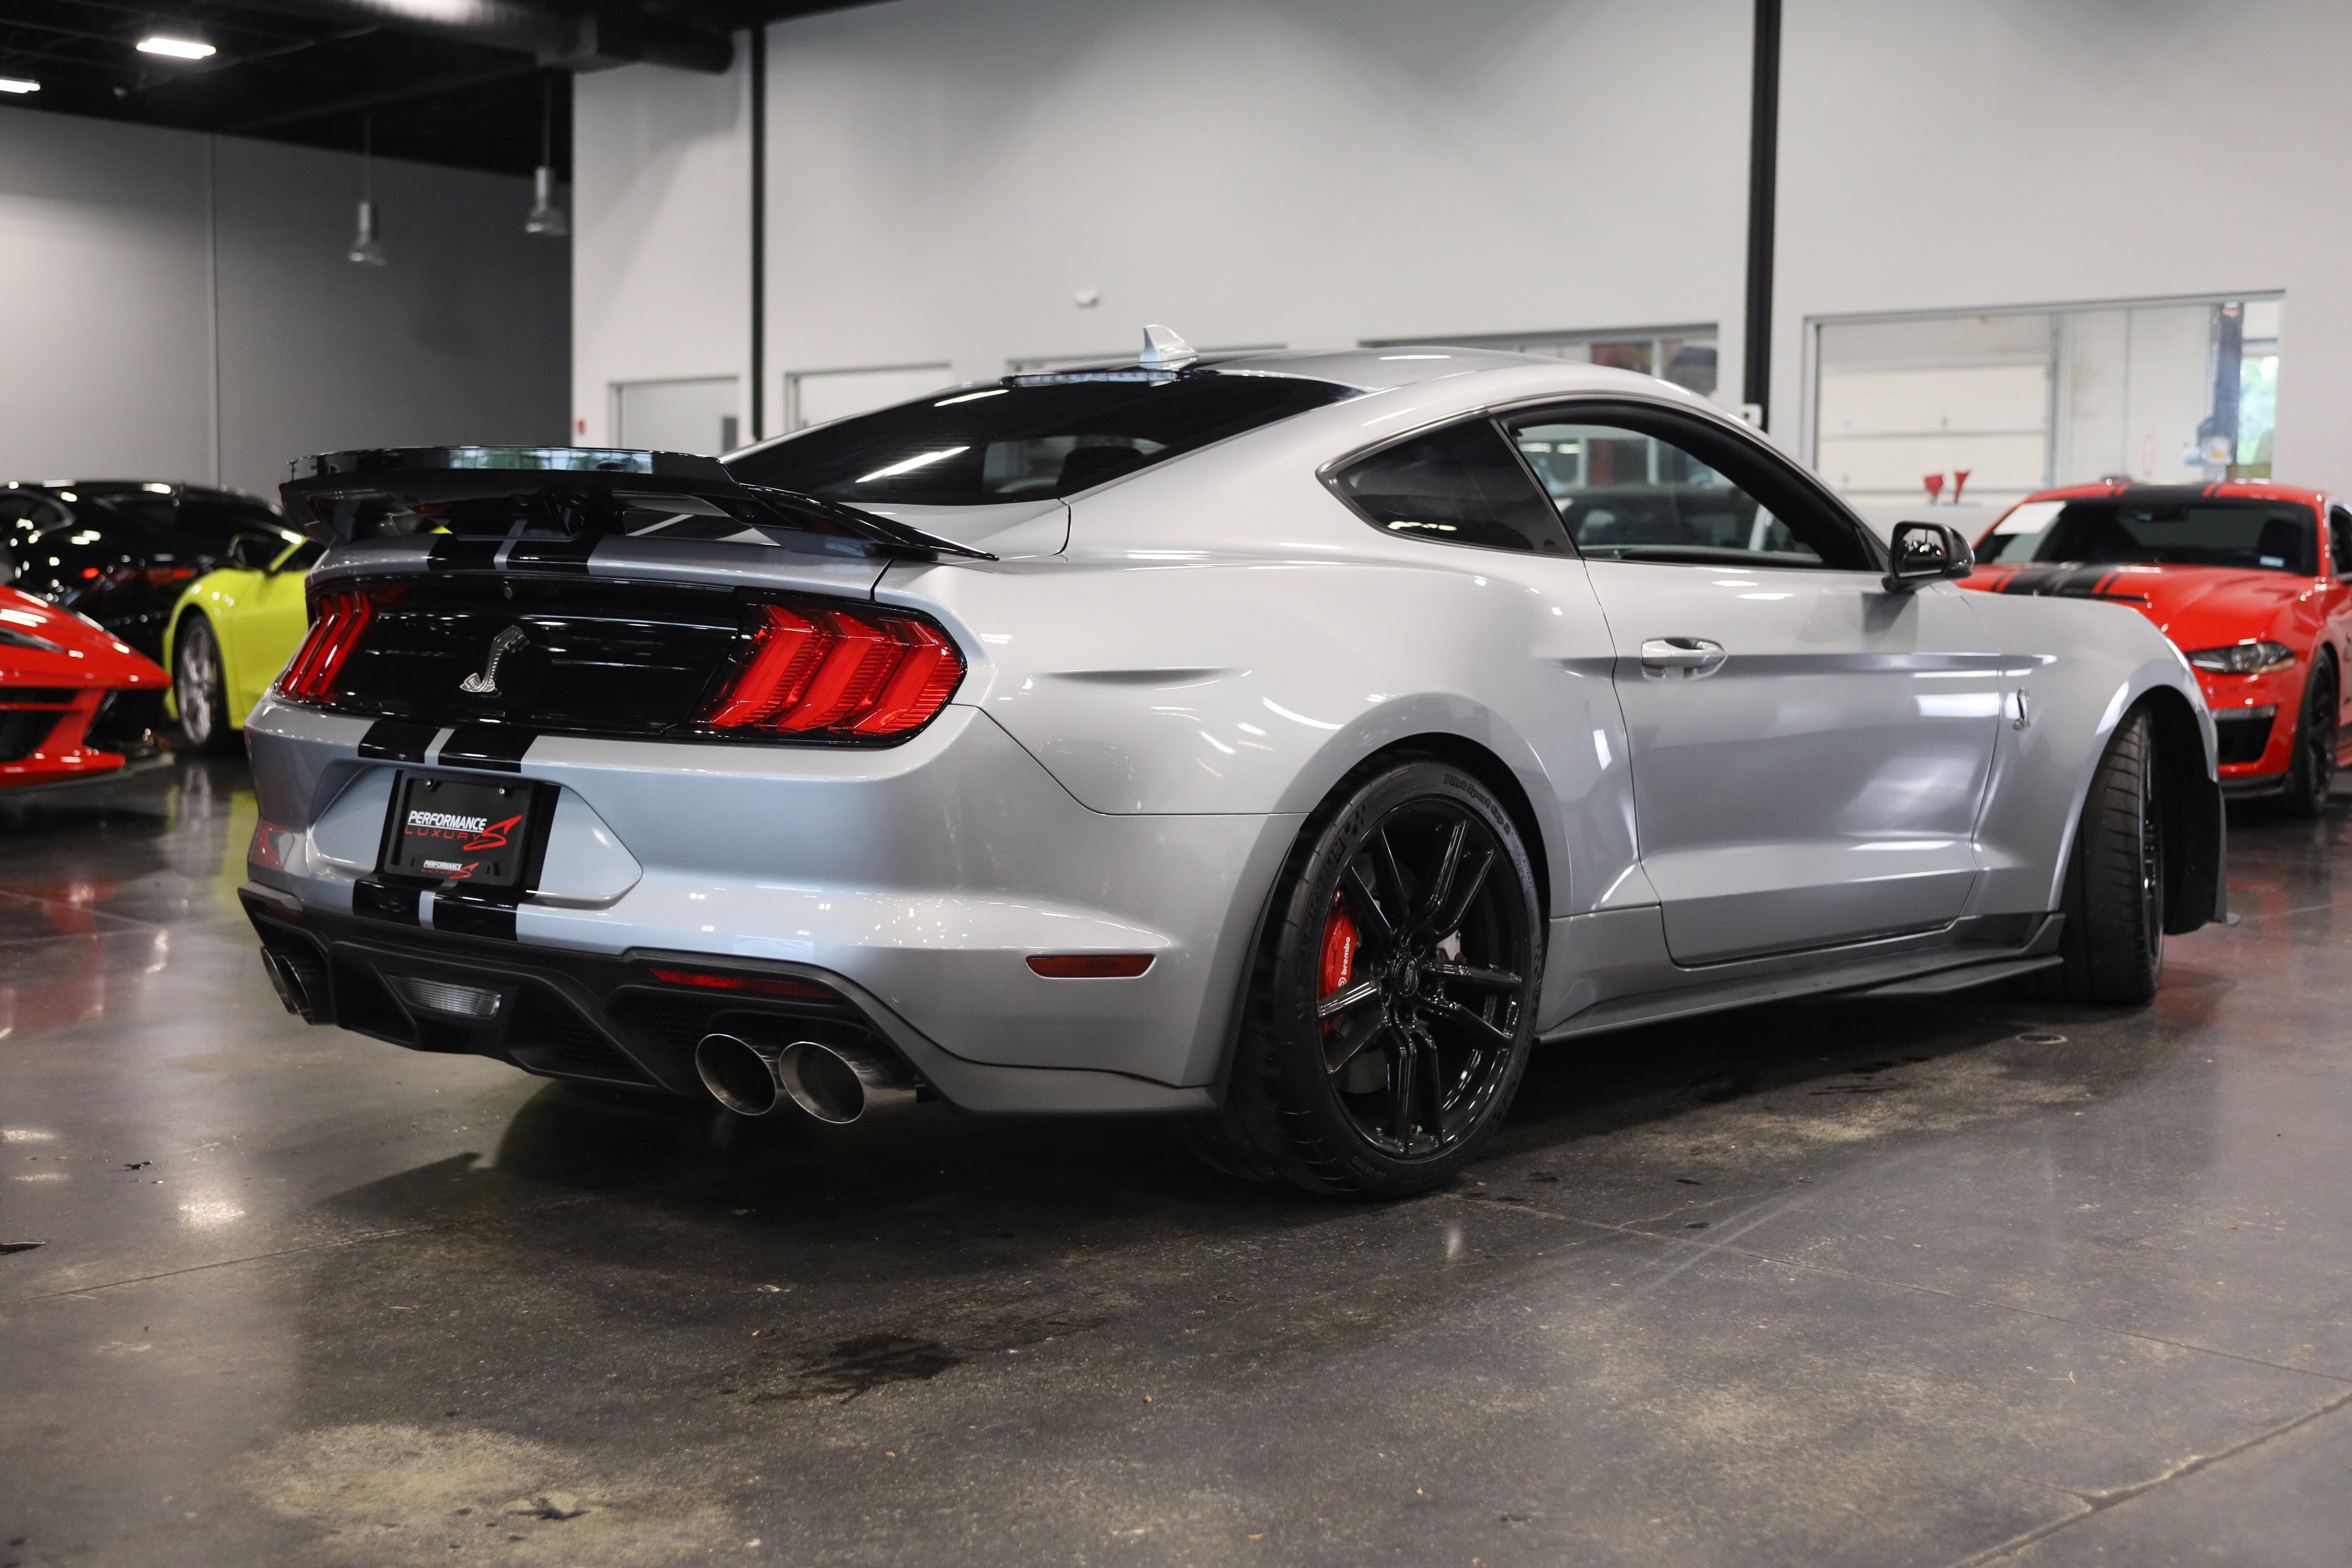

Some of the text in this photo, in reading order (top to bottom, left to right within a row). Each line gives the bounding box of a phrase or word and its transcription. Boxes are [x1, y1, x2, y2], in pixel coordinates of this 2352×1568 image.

[1444, 773, 1511, 835] Pilot Sport Cup 2
[408, 810, 487, 831] PERFORMANCE
[404, 826, 481, 841] LUXURY
[423, 860, 462, 871] PERFORMANCE
[1341, 937, 1350, 976] brembo
